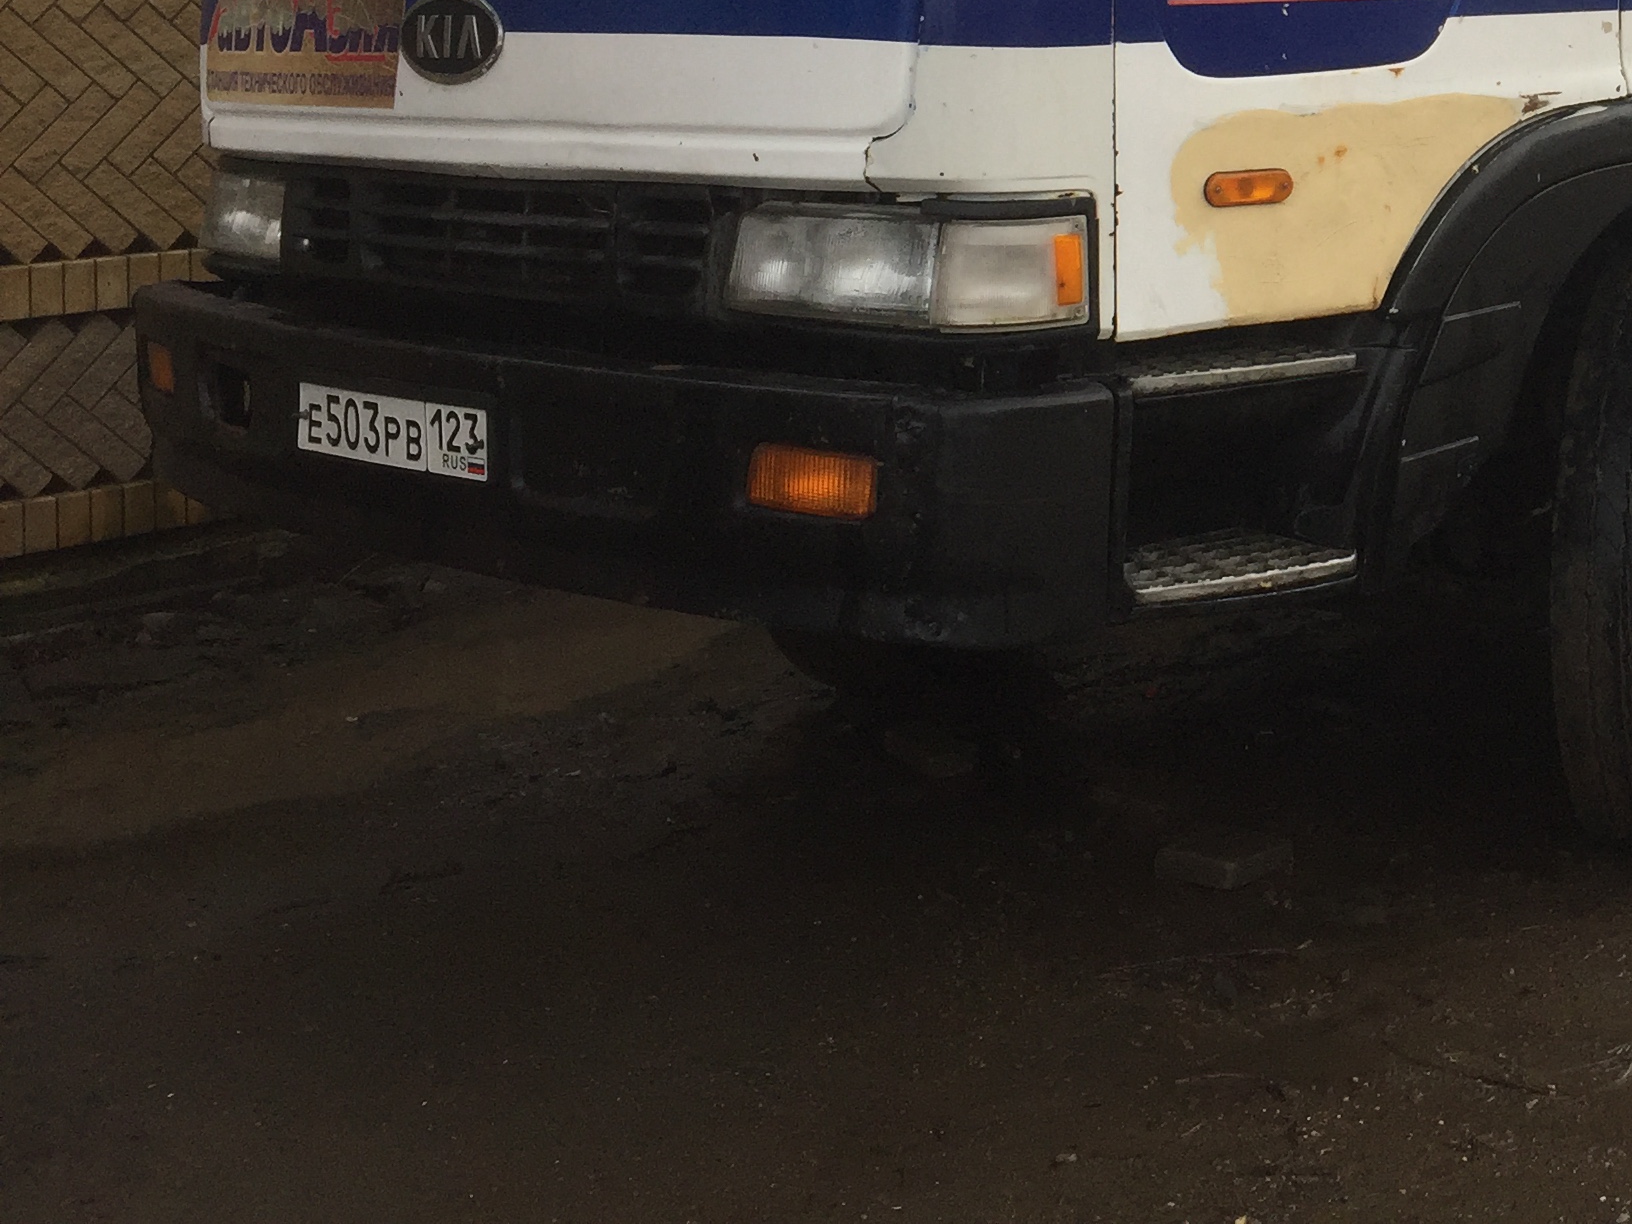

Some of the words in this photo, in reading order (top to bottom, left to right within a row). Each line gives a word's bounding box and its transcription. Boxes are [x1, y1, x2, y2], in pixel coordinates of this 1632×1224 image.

[416, 14, 483, 60] KIA
[429, 408, 484, 455] 123
[441, 453, 467, 472] RUS
